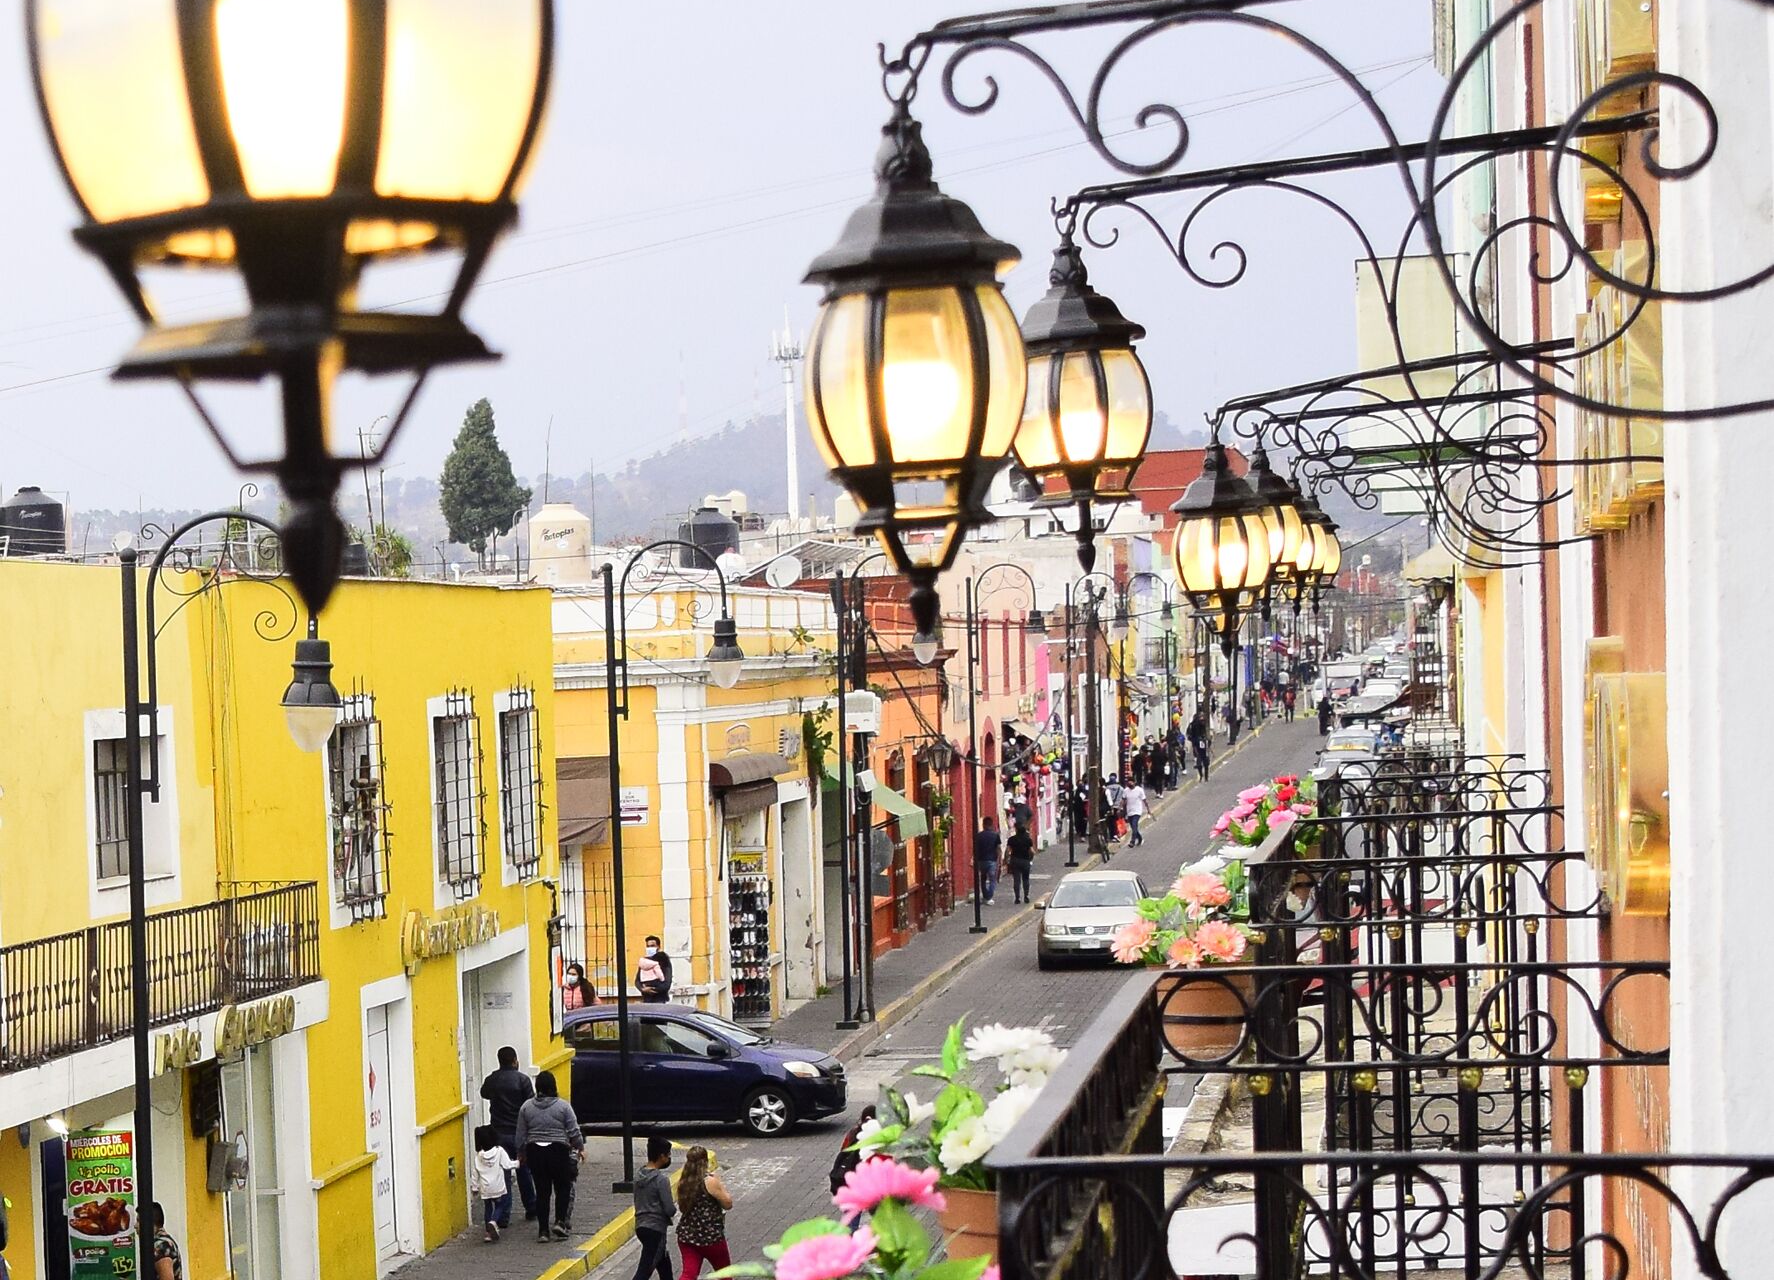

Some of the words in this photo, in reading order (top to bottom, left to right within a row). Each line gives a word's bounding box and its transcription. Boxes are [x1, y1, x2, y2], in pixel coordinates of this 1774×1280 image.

[112, 1134, 122, 1144] DE
[94, 1164, 120, 1176] pollo
[69, 1177, 133, 1197] GRATIS
